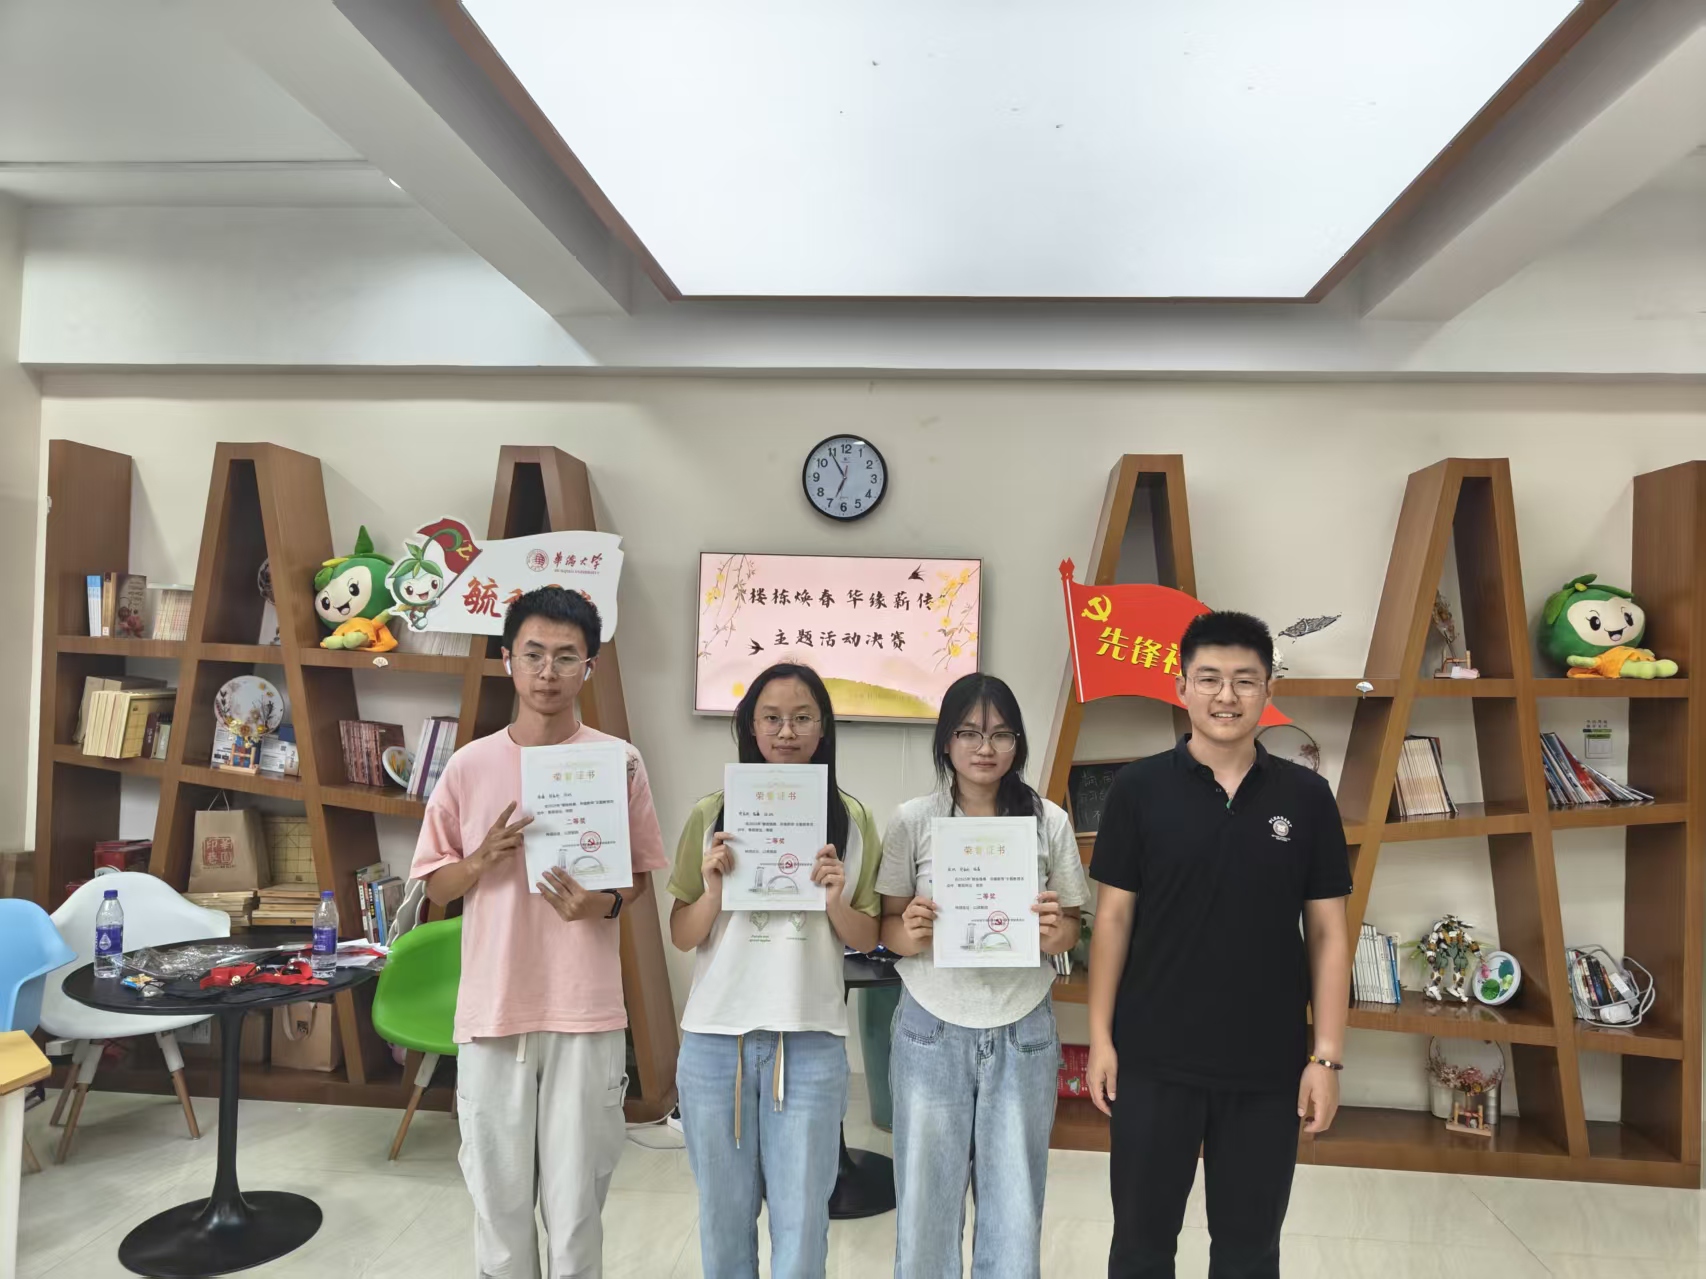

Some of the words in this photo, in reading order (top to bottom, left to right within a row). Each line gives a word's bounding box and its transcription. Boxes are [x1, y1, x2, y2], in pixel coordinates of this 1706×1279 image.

[828, 447, 837, 457] 11
[841, 444, 852, 454] 12
[858, 448, 863, 458] 1
[817, 458, 828, 468] 10
[866, 460, 873, 469] 2
[813, 472, 820, 482] 9
[870, 474, 878, 484] 3
[817, 487, 824, 497] 8
[865, 489, 872, 499] 4
[826, 498, 834, 508] 7
[840, 502, 847, 512] 6
[854, 499, 861, 508] 5
[750, 588, 835, 608] 楼栋焕春
[846, 589, 934, 611] 华缘薪传
[774, 629, 905, 651] 主题活动决赛
